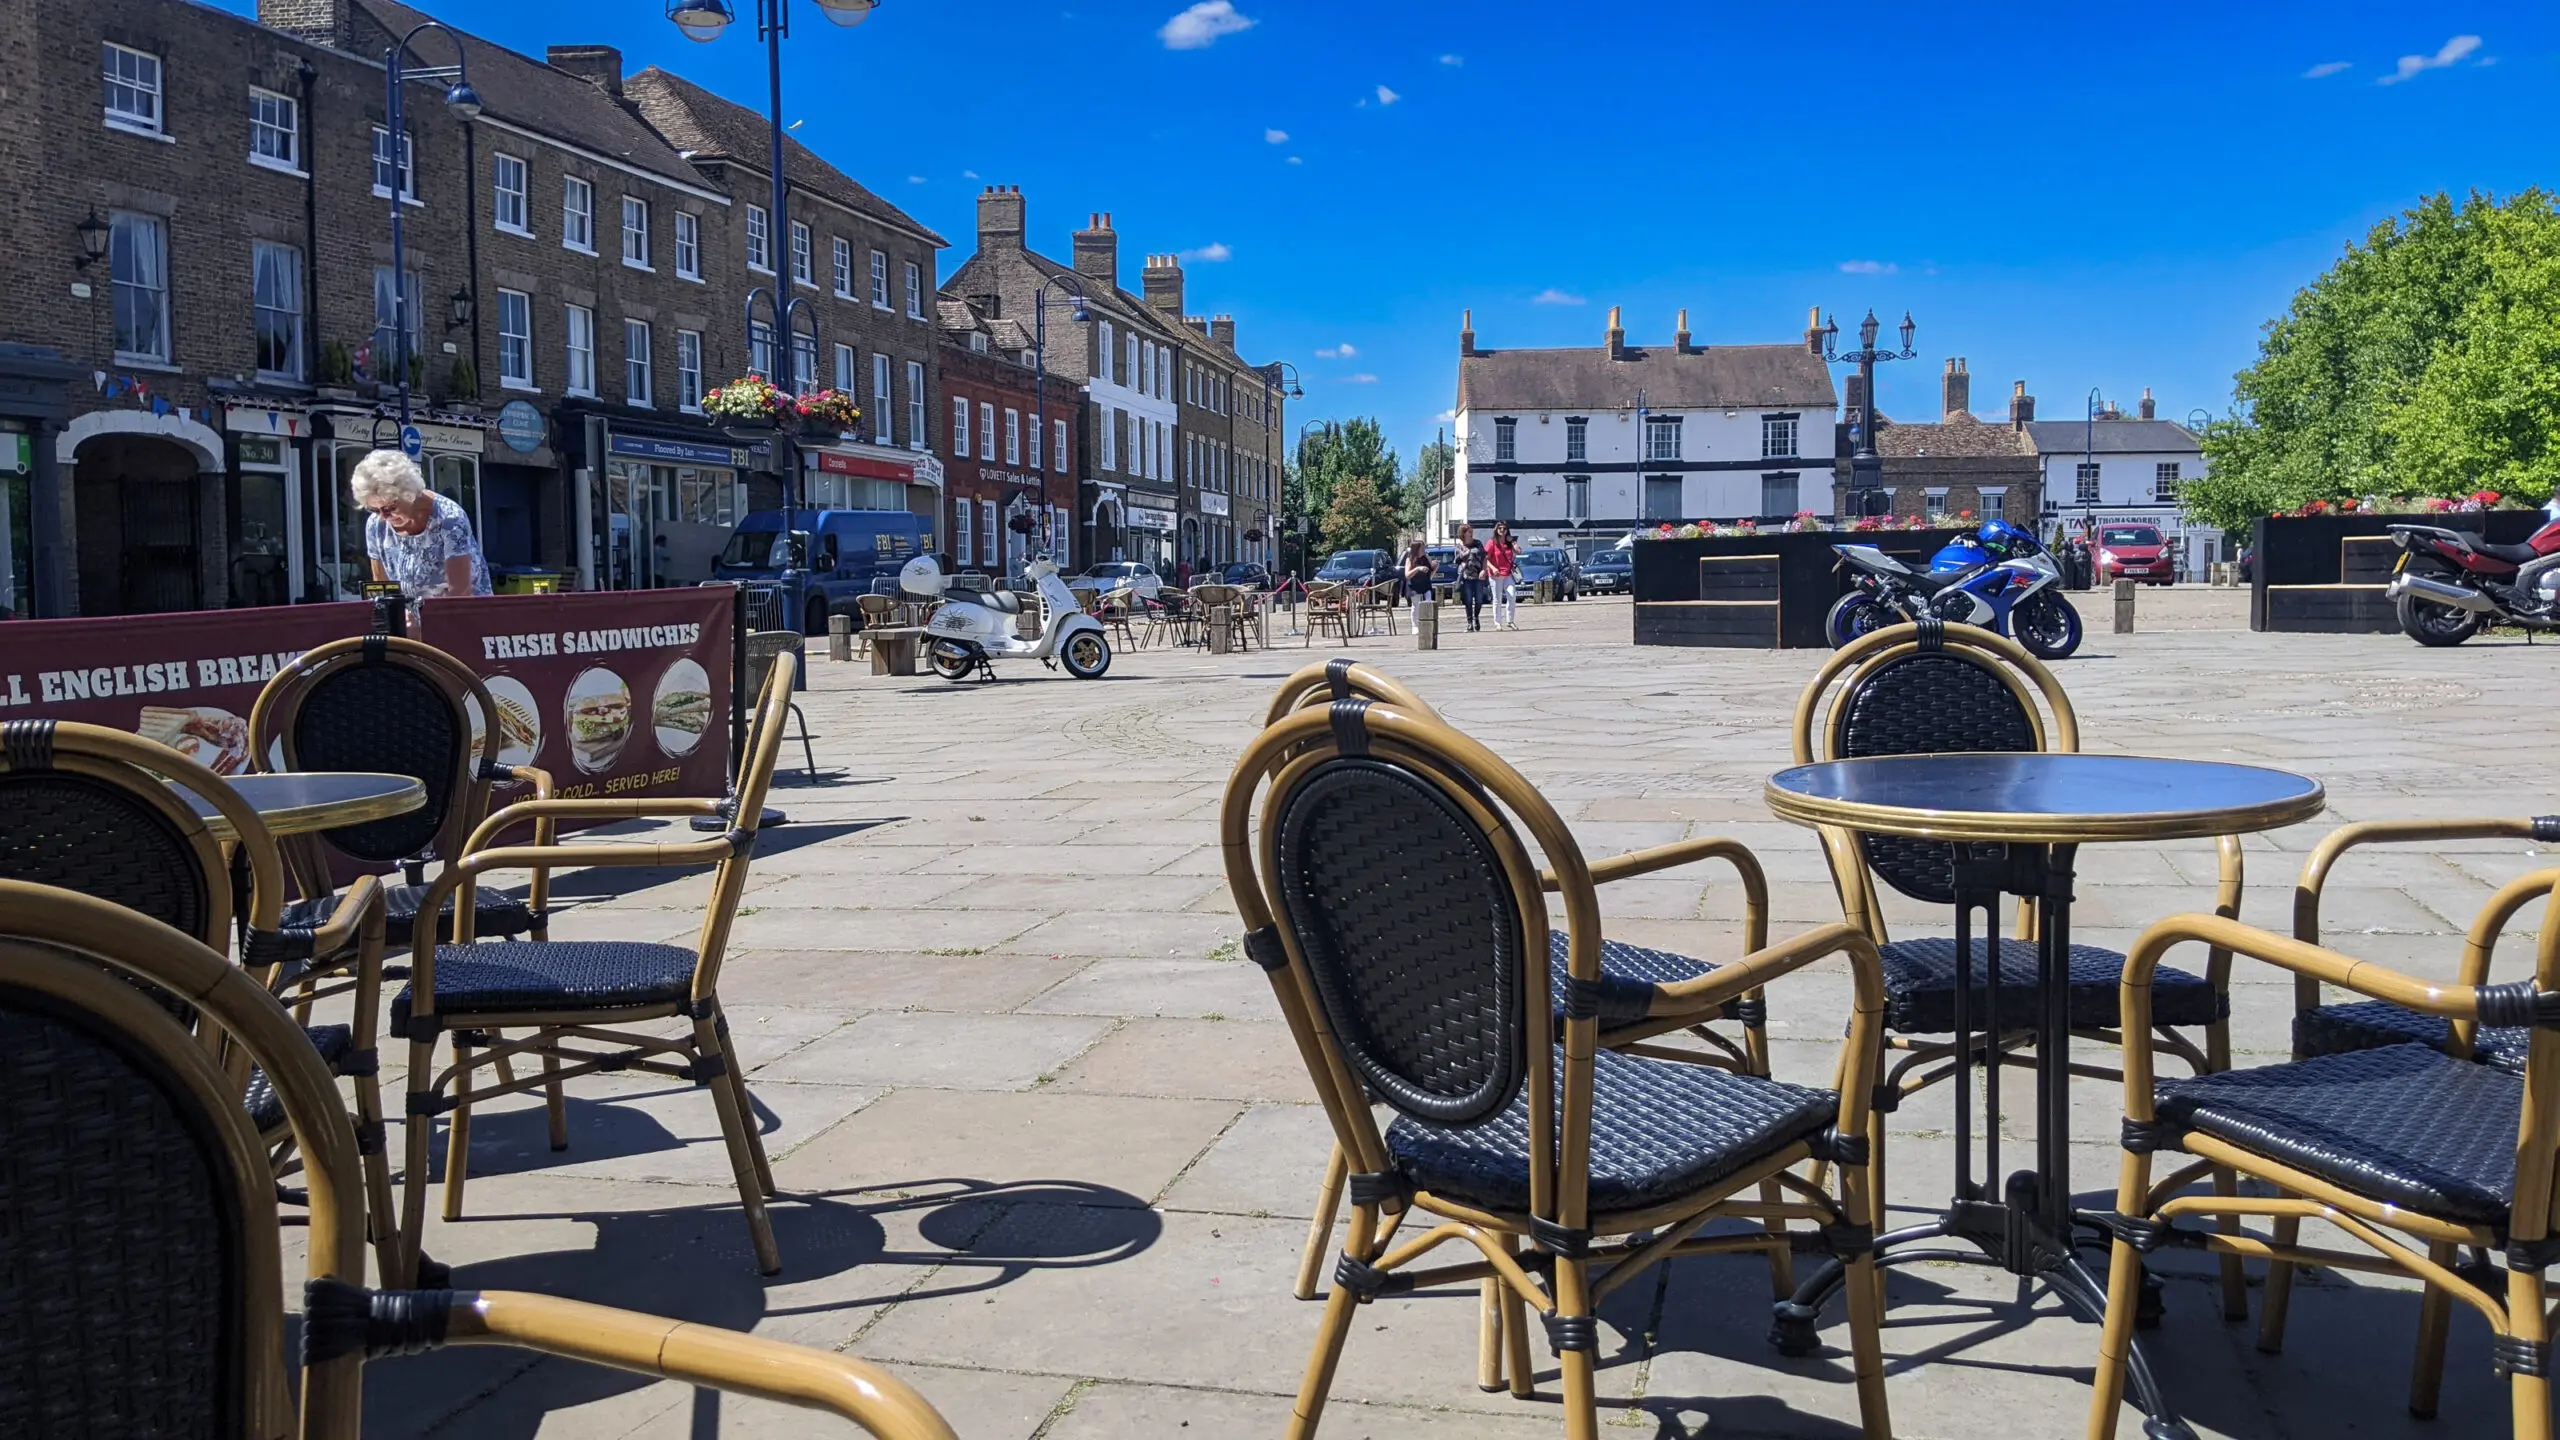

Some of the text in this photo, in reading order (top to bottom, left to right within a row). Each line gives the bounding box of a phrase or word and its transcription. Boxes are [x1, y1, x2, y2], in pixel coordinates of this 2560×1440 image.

[260, 446, 274, 460] 30
[654, 443, 676, 454] Floored
[677, 446, 684, 457] By
[685, 447, 695, 457] Ian
[730, 447, 749, 467] FBI
[986, 468, 1006, 482] LOVETT
[1006, 472, 1020, 484] Sales
[1026, 475, 1041, 487] Lettin
[875, 534, 891, 551] FBI
[481, 622, 700, 660] FRESH SANDWICHES
[38, 660, 191, 703] ENGLISH
[604, 773, 650, 794] SERVED
[652, 766, 682, 786] HERE!
